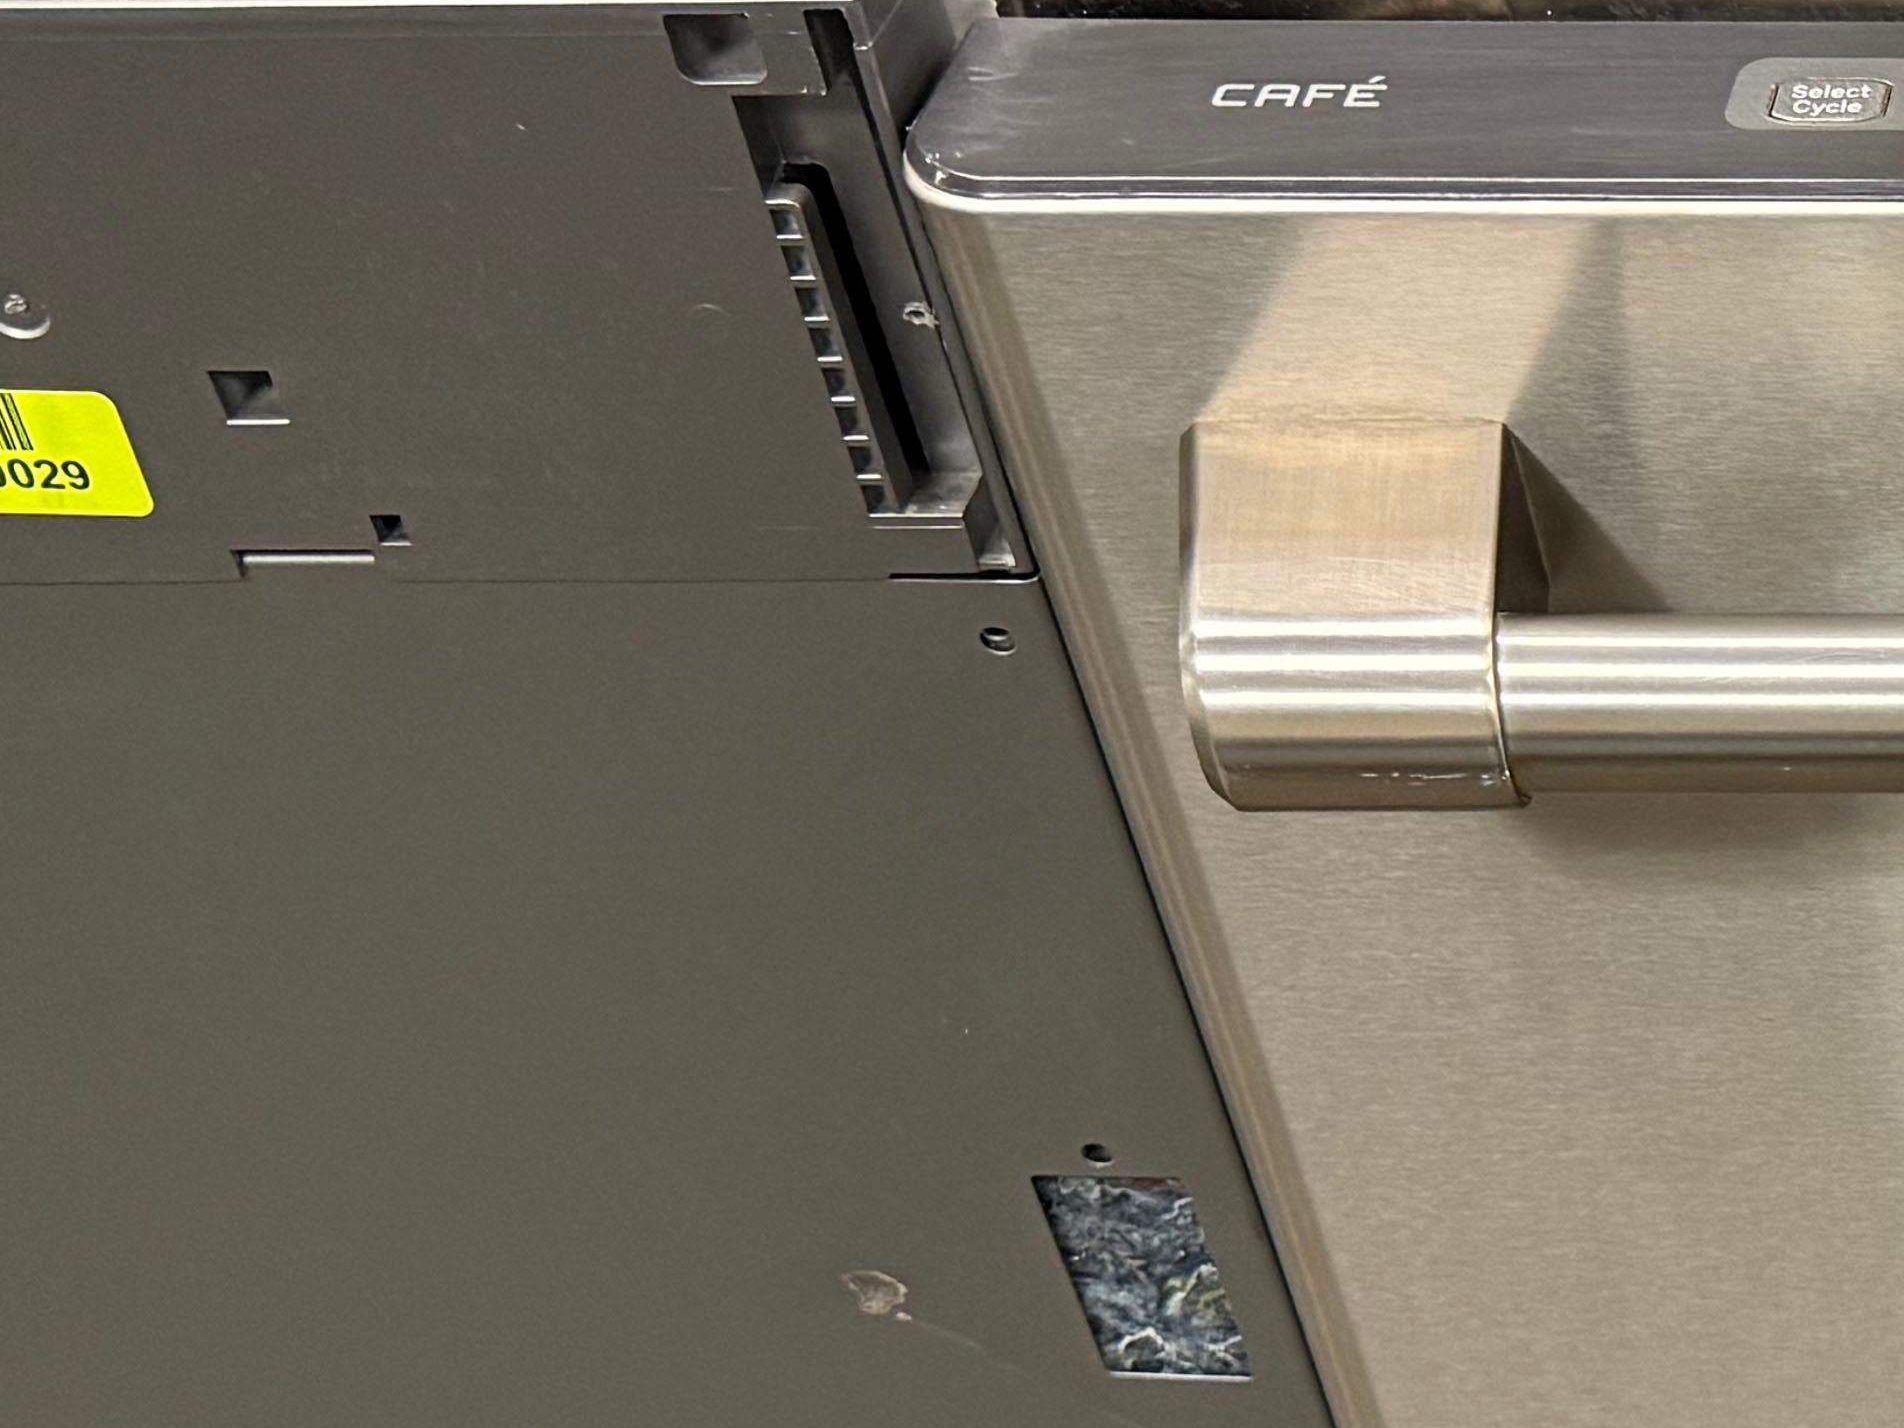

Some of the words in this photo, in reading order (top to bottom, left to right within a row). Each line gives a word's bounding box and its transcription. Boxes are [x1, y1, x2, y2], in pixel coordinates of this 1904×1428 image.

[1211, 75, 1388, 108] CAFÉ
[1791, 83, 1873, 99] Select
[1792, 100, 1863, 116] Cycle
[0, 458, 91, 490] 029
